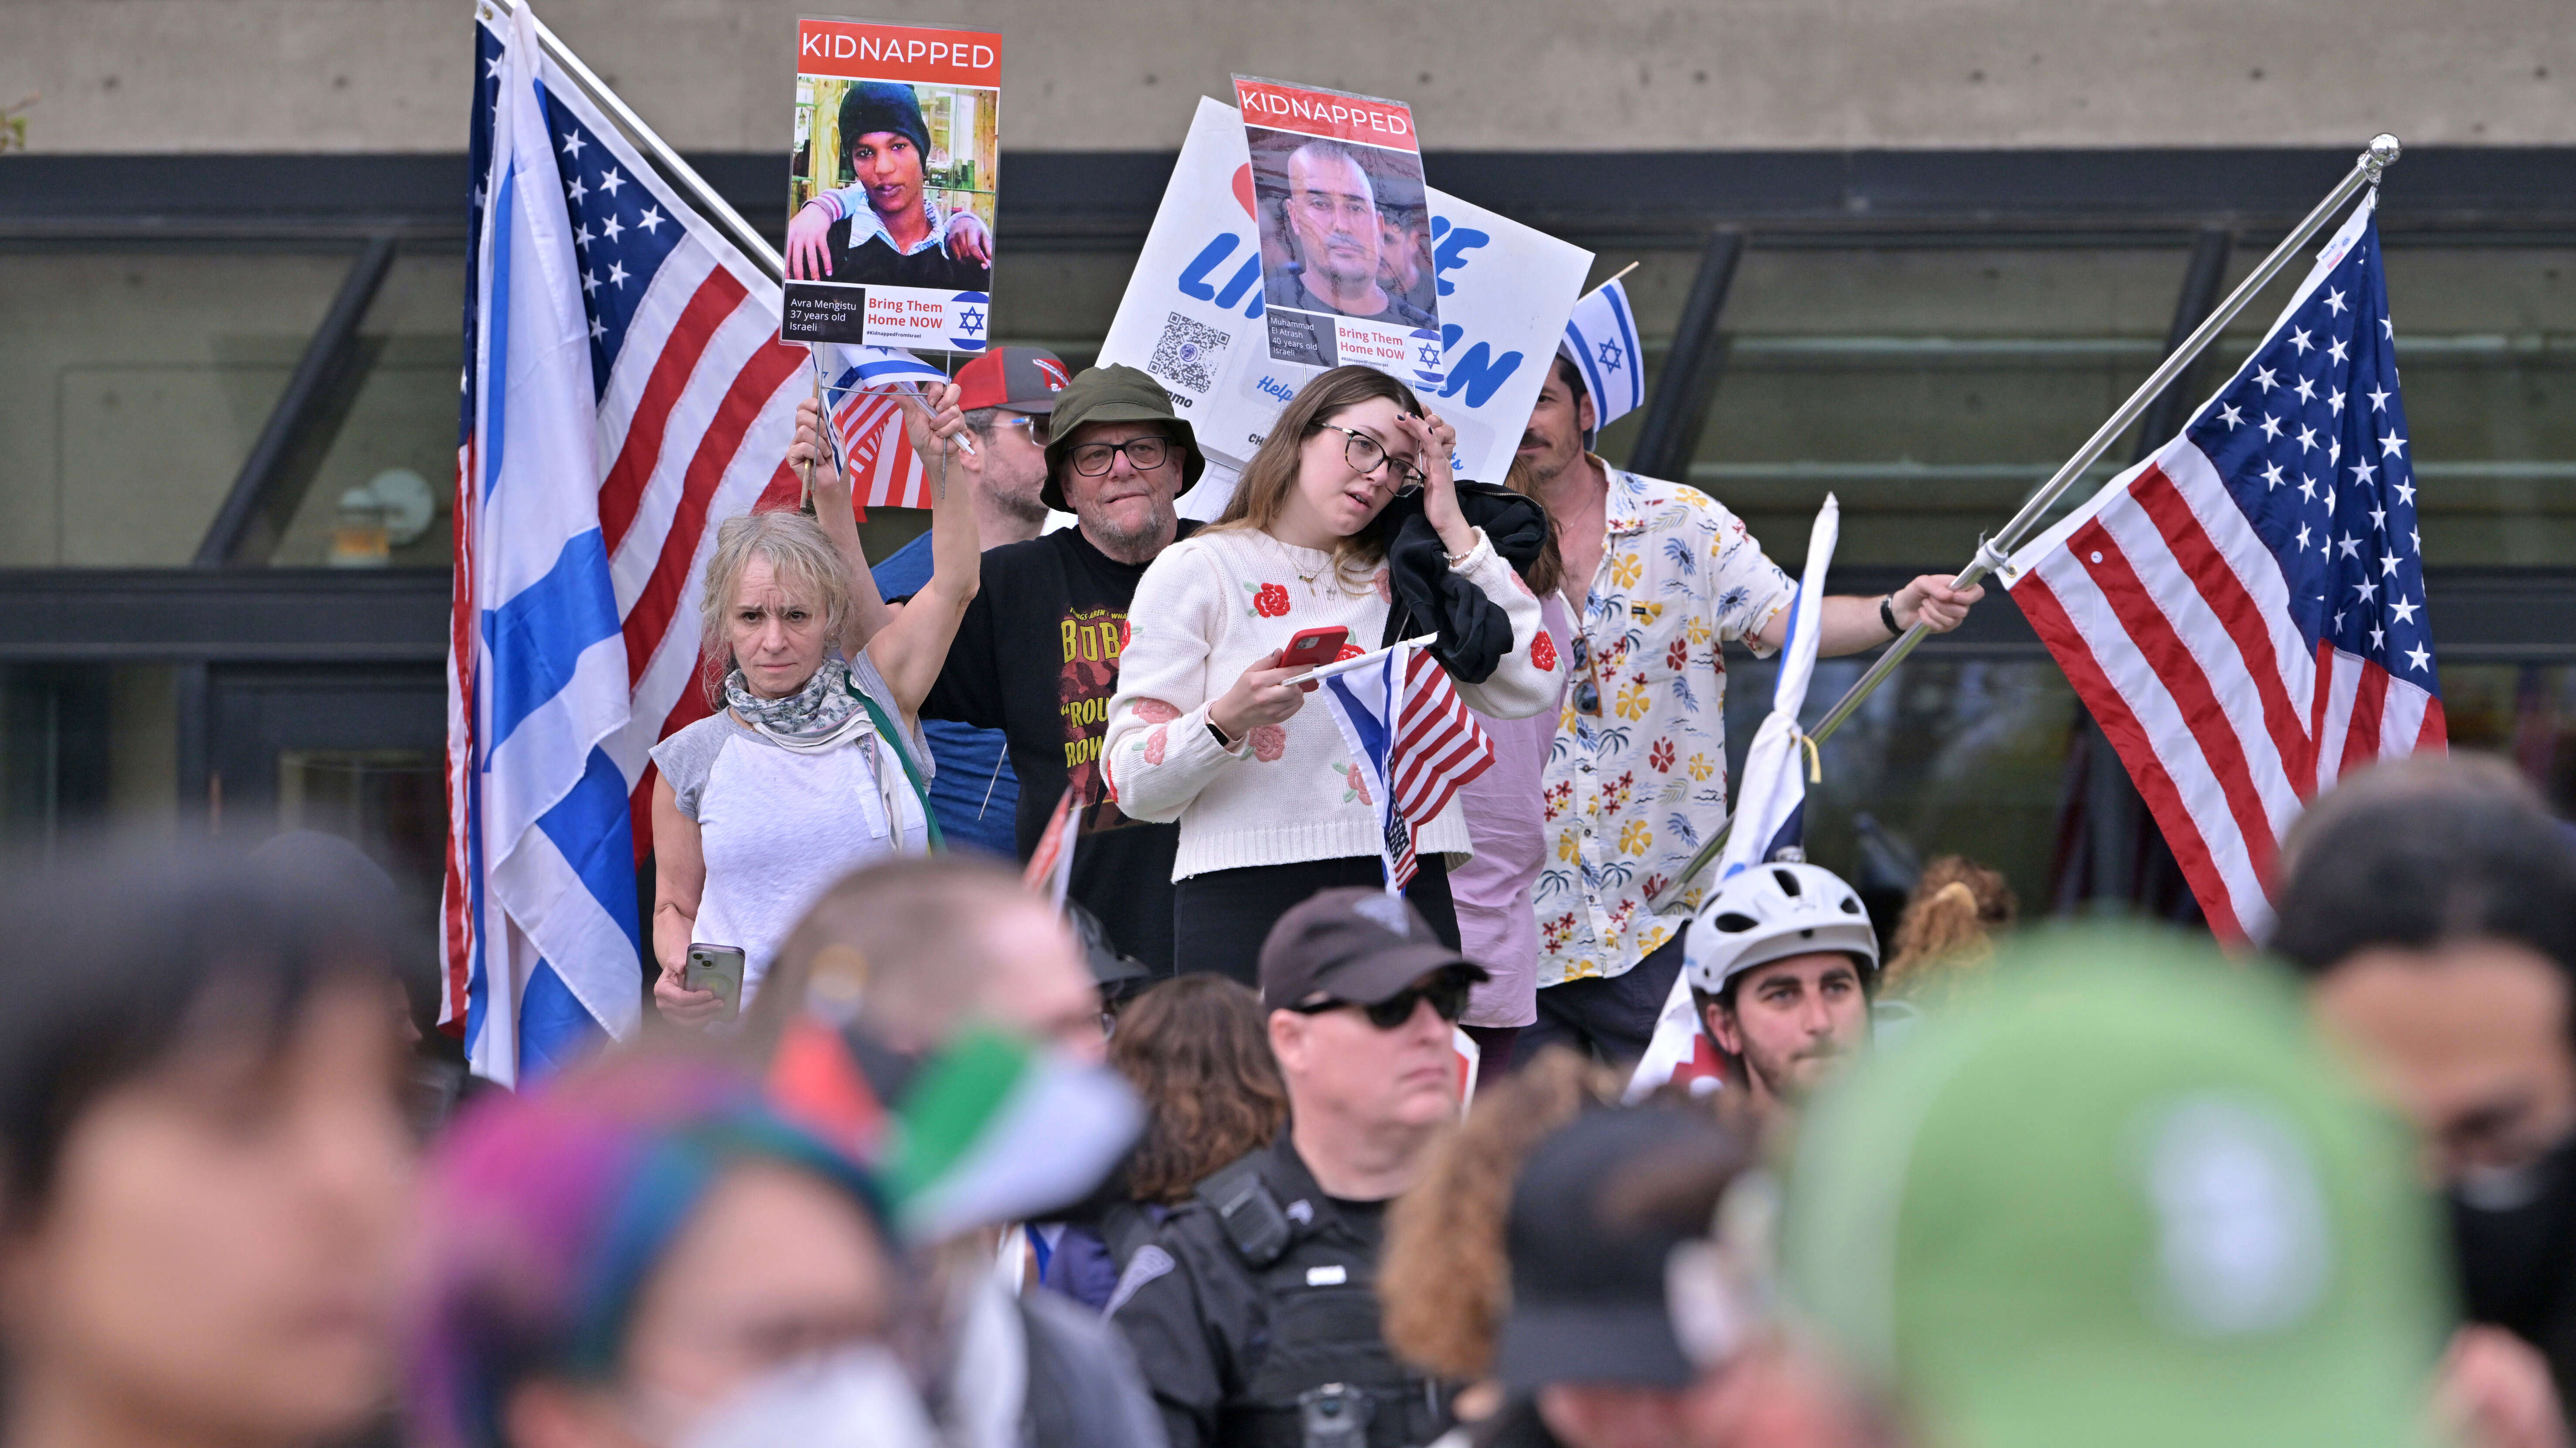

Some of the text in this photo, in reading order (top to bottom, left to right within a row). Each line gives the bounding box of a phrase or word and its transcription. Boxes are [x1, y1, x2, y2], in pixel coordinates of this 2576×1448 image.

[802, 33, 994, 68] KIDNAPPED
[1241, 90, 1407, 134] KIDNAPPED
[791, 298, 856, 311] Avra Mengistu
[869, 298, 942, 313] Bring Them
[790, 310, 845, 321] 37 years old
[868, 314, 943, 328] Home NOW
[790, 322, 817, 331] Israeli
[1271, 317, 1314, 330] Muhammad
[1280, 329, 1303, 338] Atrash
[1339, 327, 1403, 346] Bring Them
[1274, 347, 1295, 356] Israeli
[1341, 341, 1404, 360] Home NOW
[1341, 357, 1388, 367] #KidnappedFromIsrael
[1257, 376, 1295, 402] Help
[1061, 619, 1121, 664] BOB
[1065, 735, 1107, 768] ROW
